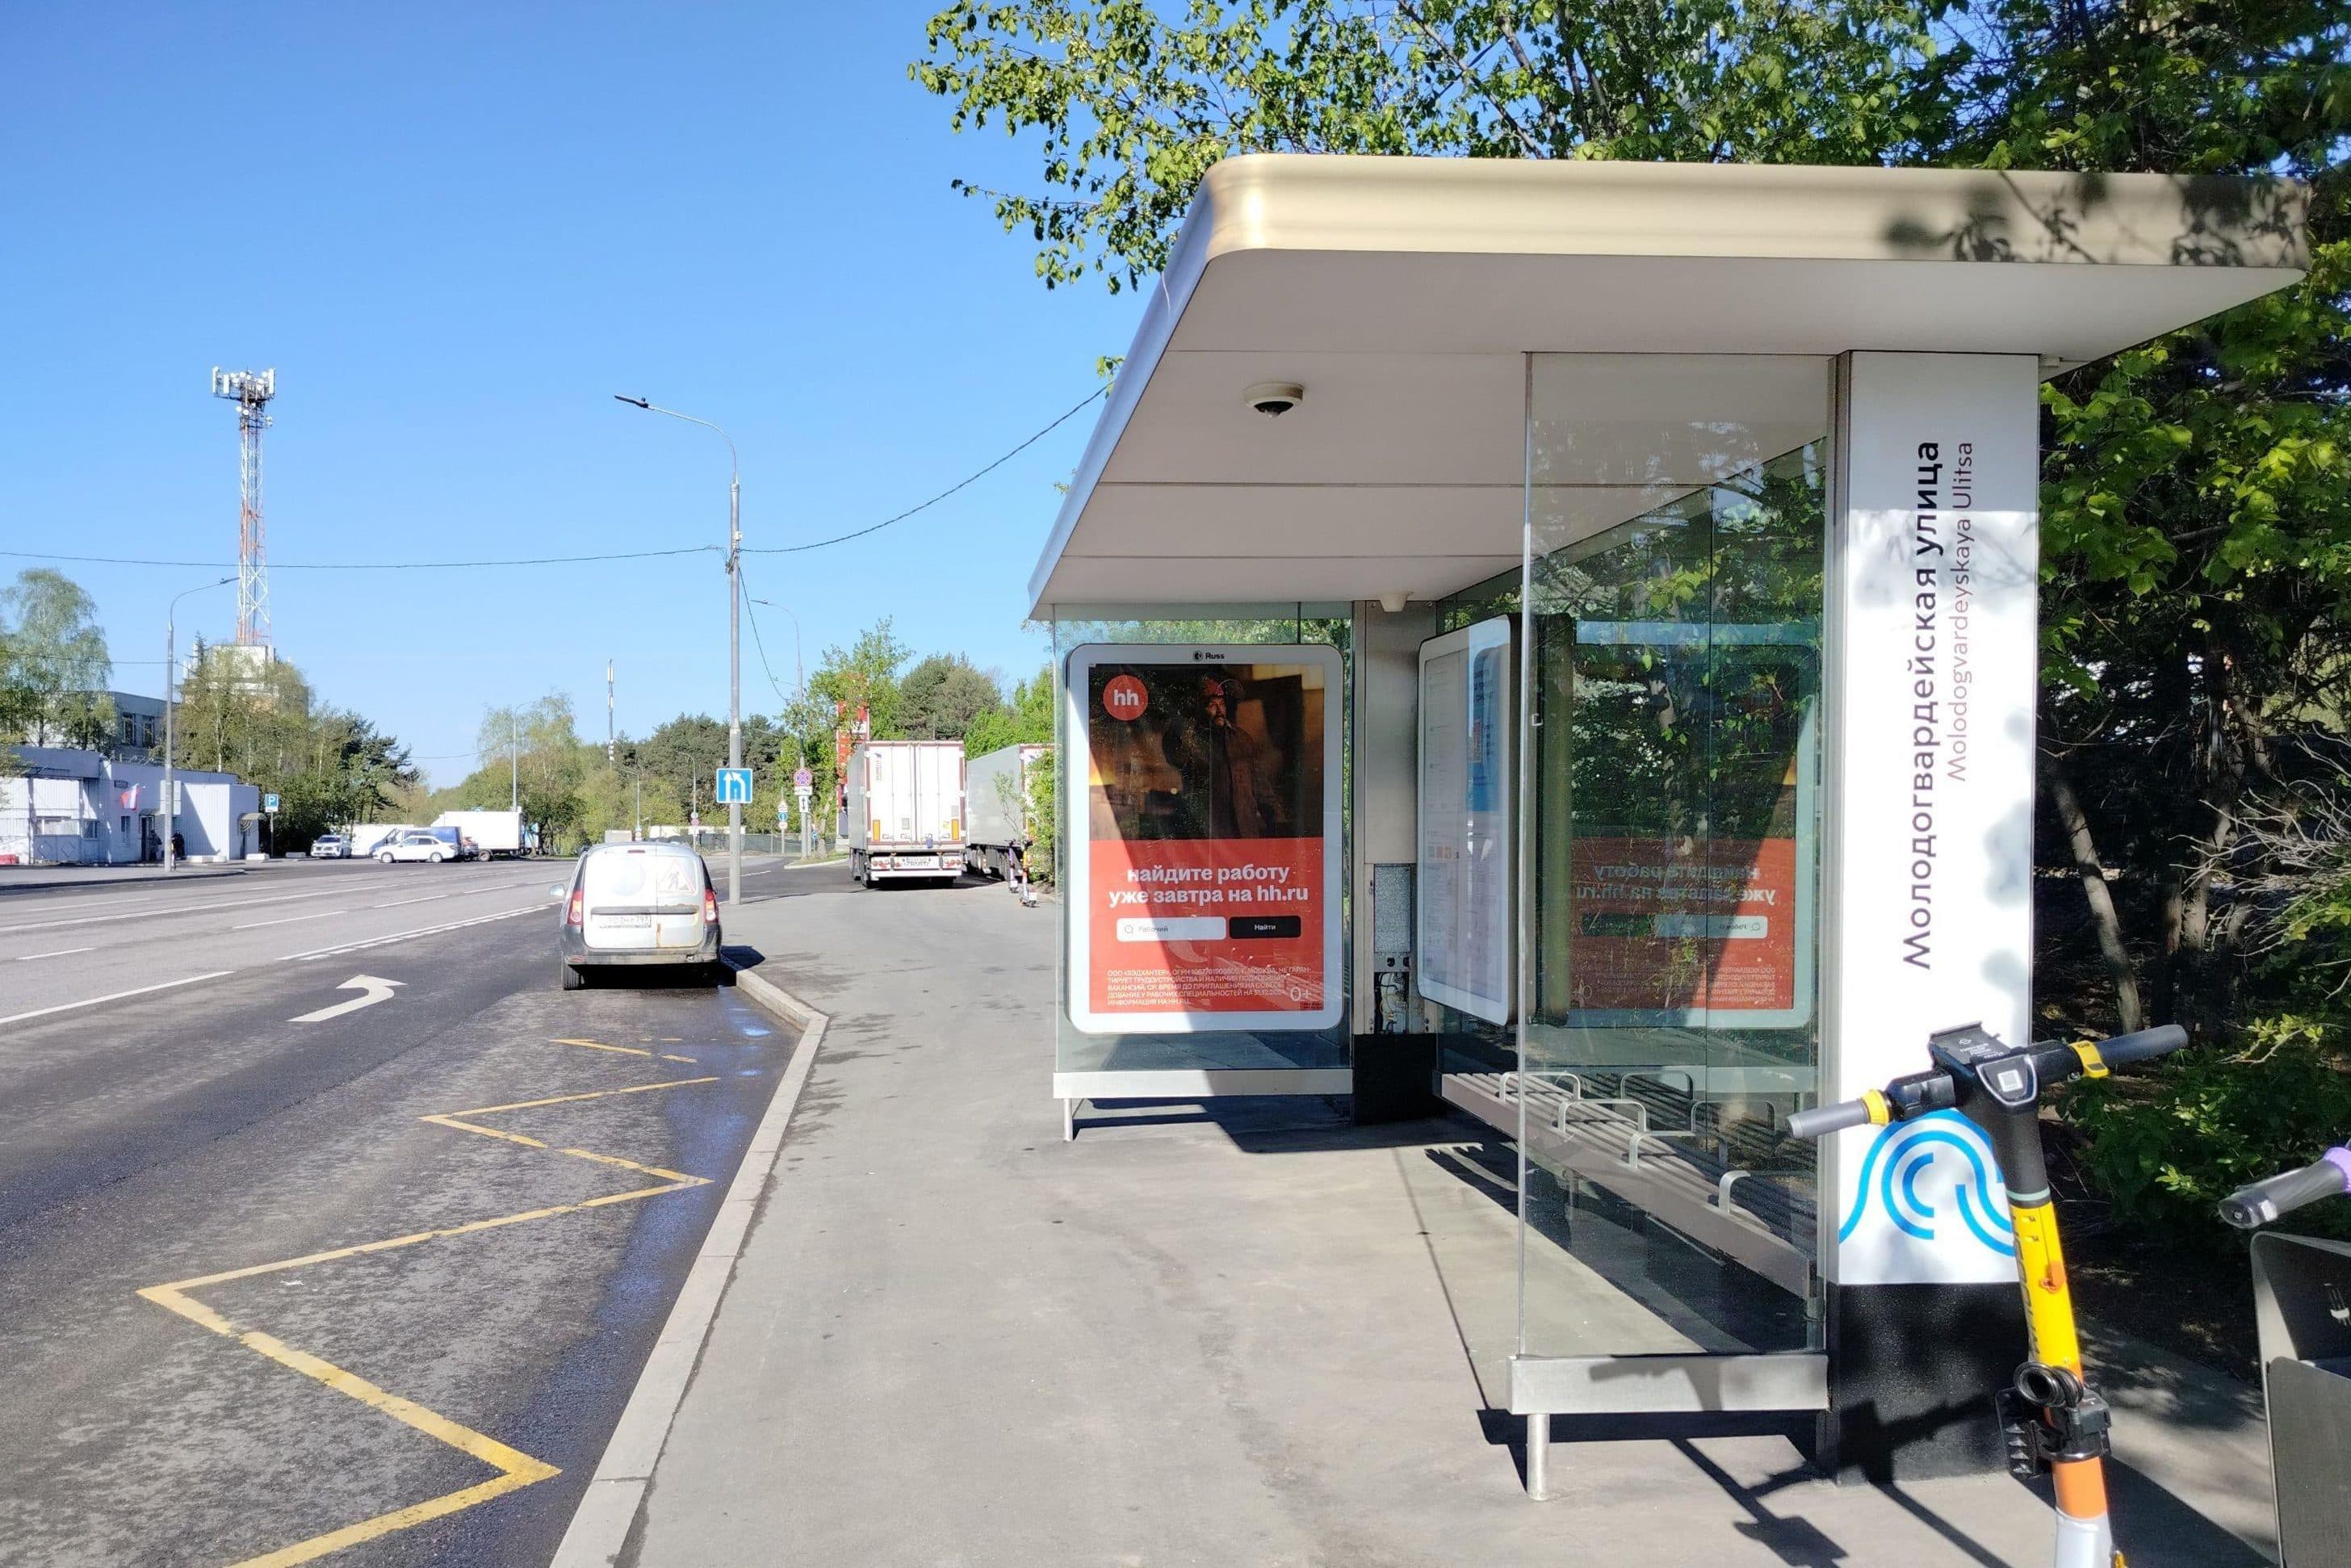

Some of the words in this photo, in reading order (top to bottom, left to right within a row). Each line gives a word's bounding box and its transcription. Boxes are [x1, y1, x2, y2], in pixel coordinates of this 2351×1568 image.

[1952, 441, 1972, 509] Ulitsa
[1916, 441, 1943, 556] улица
[1947, 518, 1976, 782] Molodogvardeyskaya
[1113, 689, 1139, 706] hh
[1903, 568, 1941, 969] Молодогвардейская
[268, 795, 276, 806] P
[1127, 866, 1213, 884] найдите
[1217, 864, 1290, 884] работу
[1108, 890, 1149, 907] уже
[1153, 890, 1224, 905] завтра
[1228, 888, 1253, 901] на
[1257, 885, 1309, 901] hh.ru
[1254, 923, 1276, 931] Найти
[1290, 987, 1311, 1001] 0+
